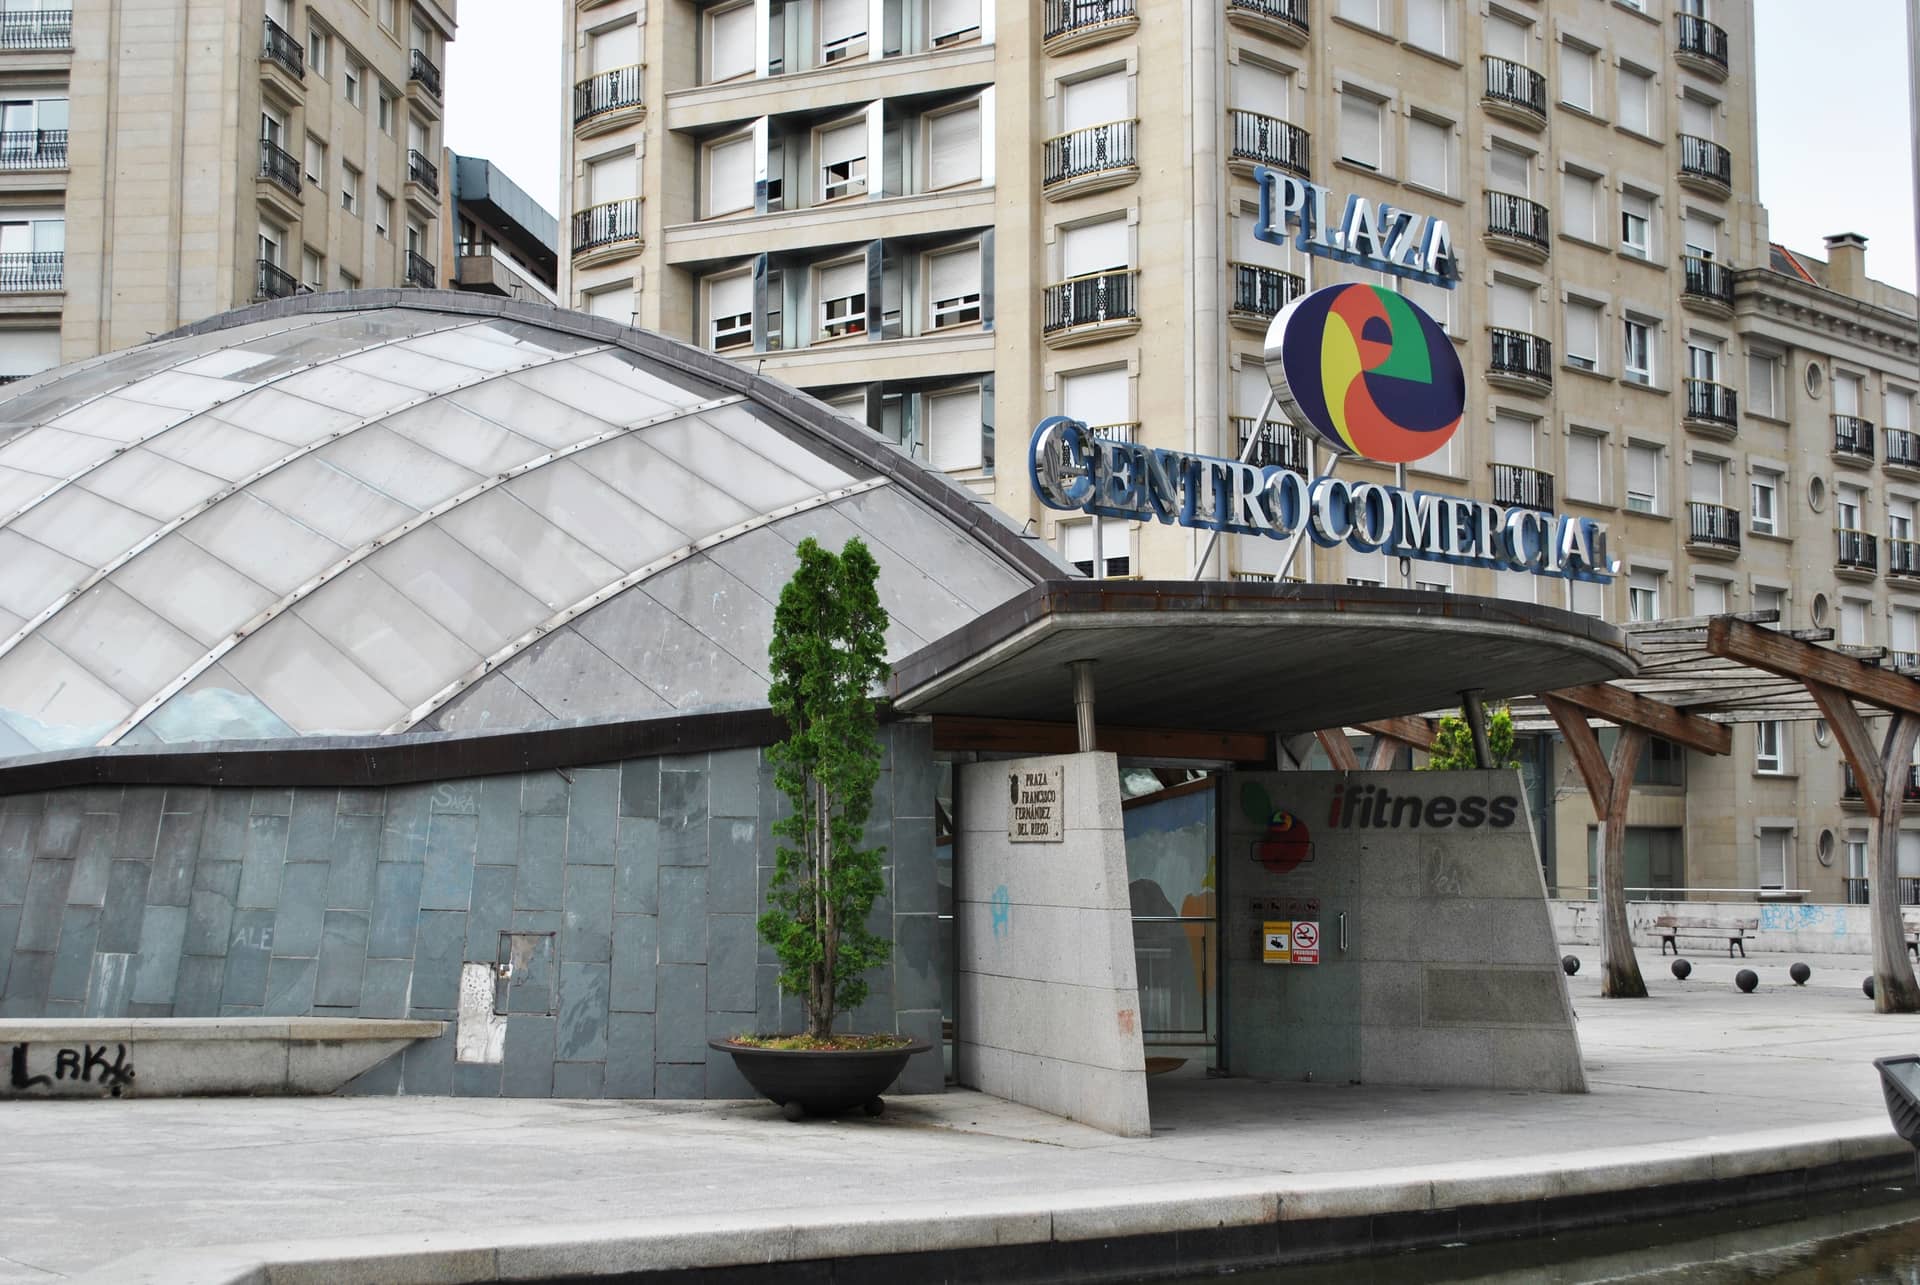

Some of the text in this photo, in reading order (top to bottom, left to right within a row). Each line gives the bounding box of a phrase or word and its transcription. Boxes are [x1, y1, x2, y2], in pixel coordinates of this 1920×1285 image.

[1254, 165, 1462, 289] PLAZA
[1026, 773, 1048, 786] PRAZA
[1328, 784, 1518, 829] ifitness
[1017, 823, 1029, 836] DEL
[231, 927, 274, 950] ALE
